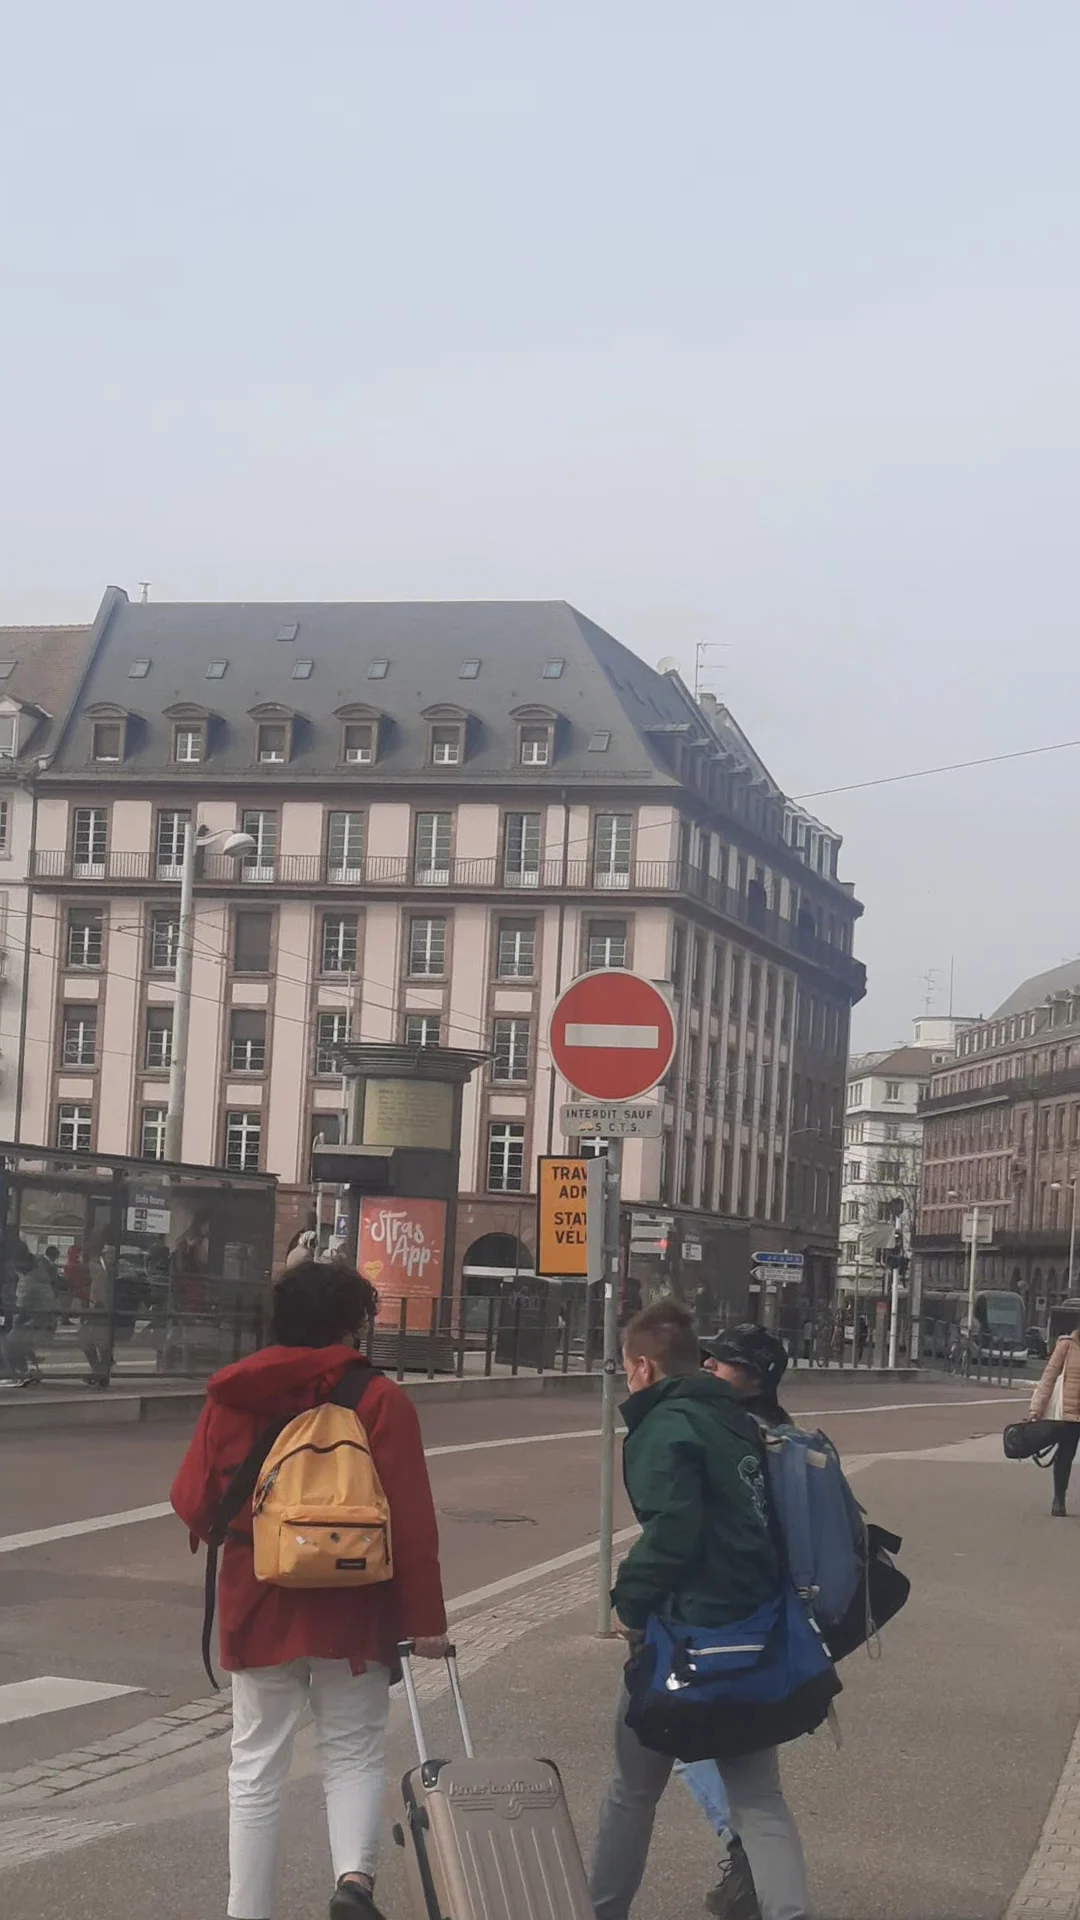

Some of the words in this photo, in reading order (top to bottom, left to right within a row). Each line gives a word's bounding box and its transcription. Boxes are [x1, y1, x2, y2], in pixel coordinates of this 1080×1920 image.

[566, 1109, 617, 1119] INTERDIT
[624, 1109, 653, 1119] SAUF
[608, 1122, 641, 1132] C.T.S.
[555, 1226, 588, 1244] VÉL
[390, 1234, 432, 1277] App
